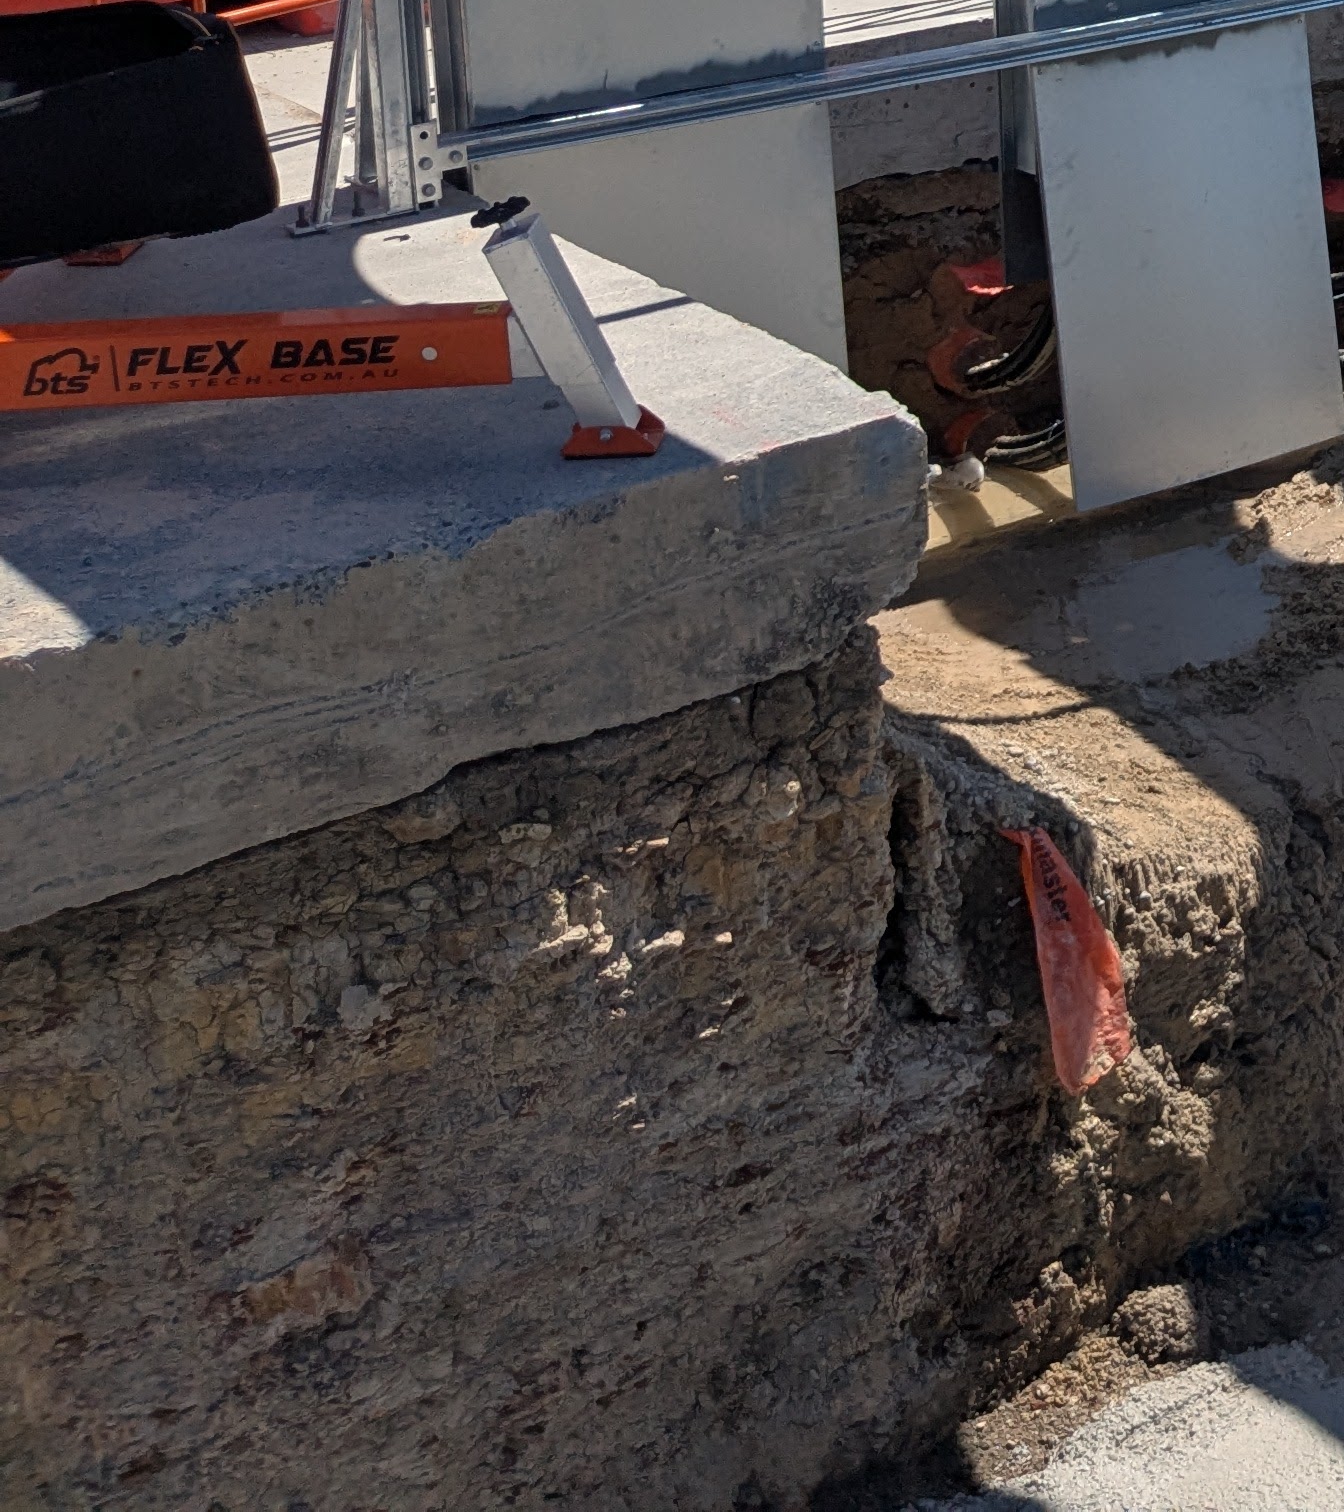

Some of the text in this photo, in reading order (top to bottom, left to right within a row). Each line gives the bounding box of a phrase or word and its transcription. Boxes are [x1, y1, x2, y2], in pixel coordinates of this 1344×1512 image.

[126, 335, 401, 377] FLEX BASE
[128, 368, 401, 392] BTSTECH.COM.AU
